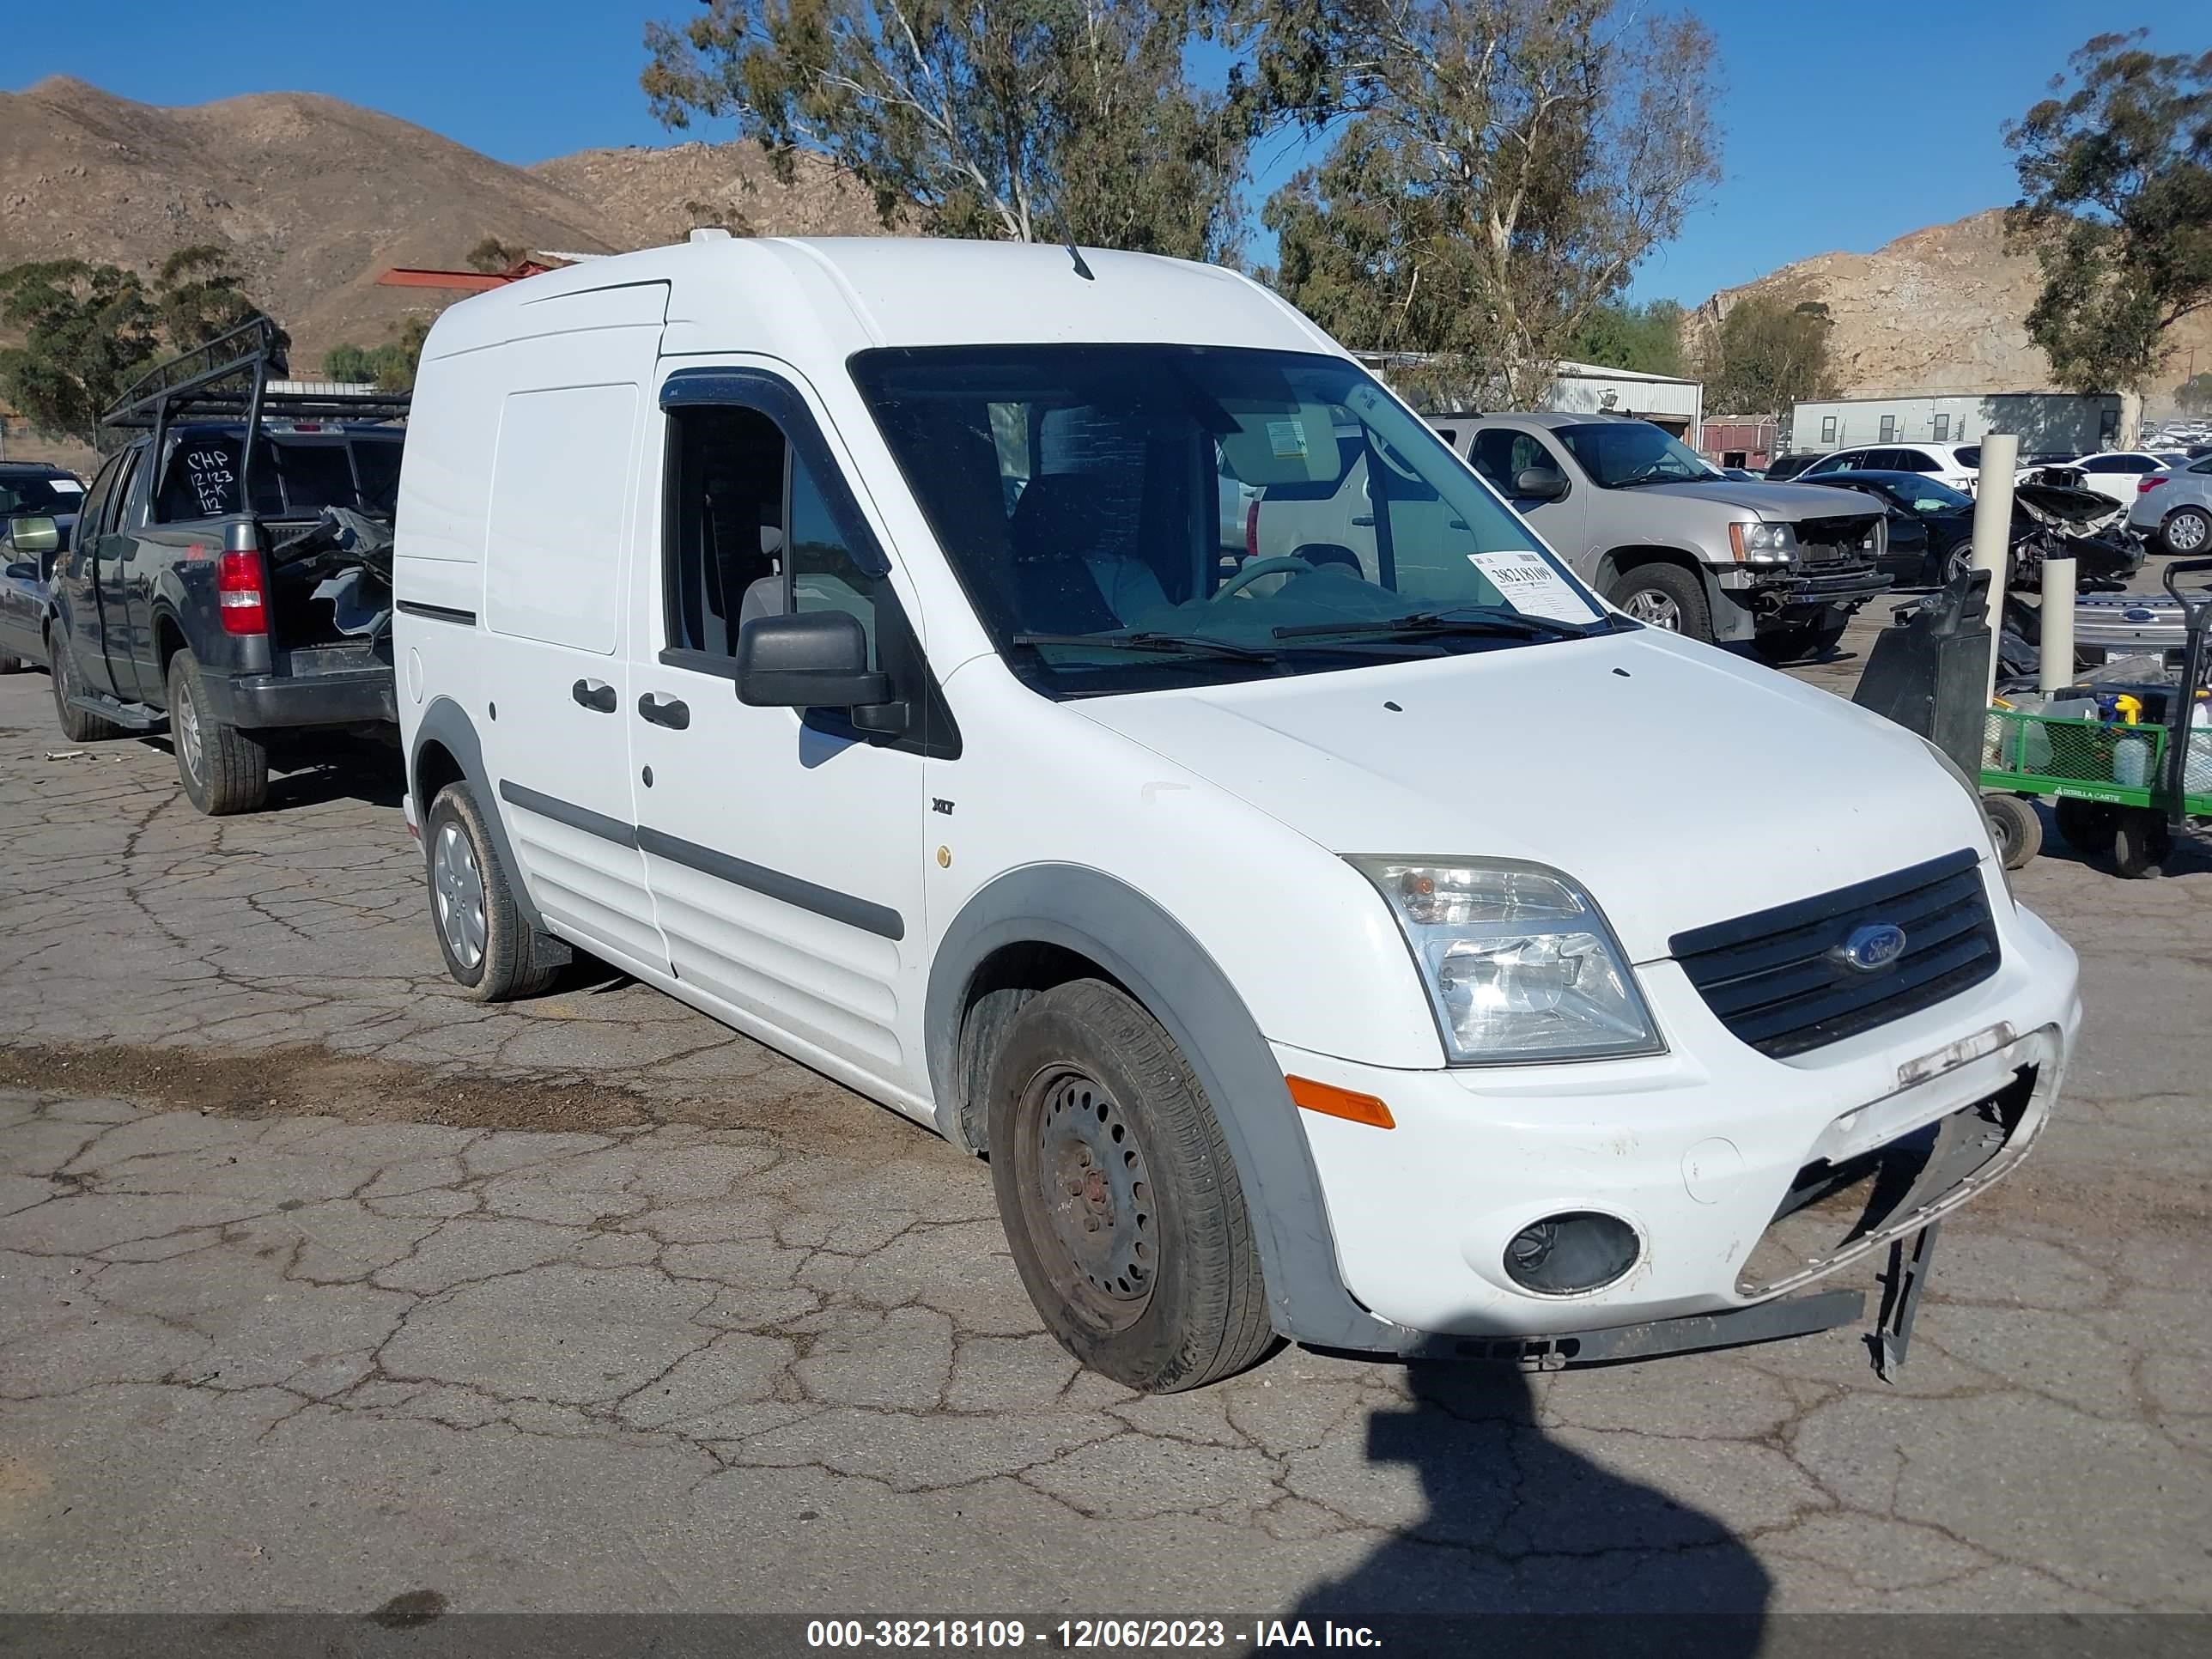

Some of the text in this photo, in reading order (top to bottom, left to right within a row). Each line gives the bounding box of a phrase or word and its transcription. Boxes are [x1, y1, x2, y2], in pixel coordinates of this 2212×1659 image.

[187, 451, 228, 470] CHP
[1492, 566, 1553, 584] 38218109
[2063, 788, 2093, 799] GORILLA
[932, 797, 956, 816] XLT
